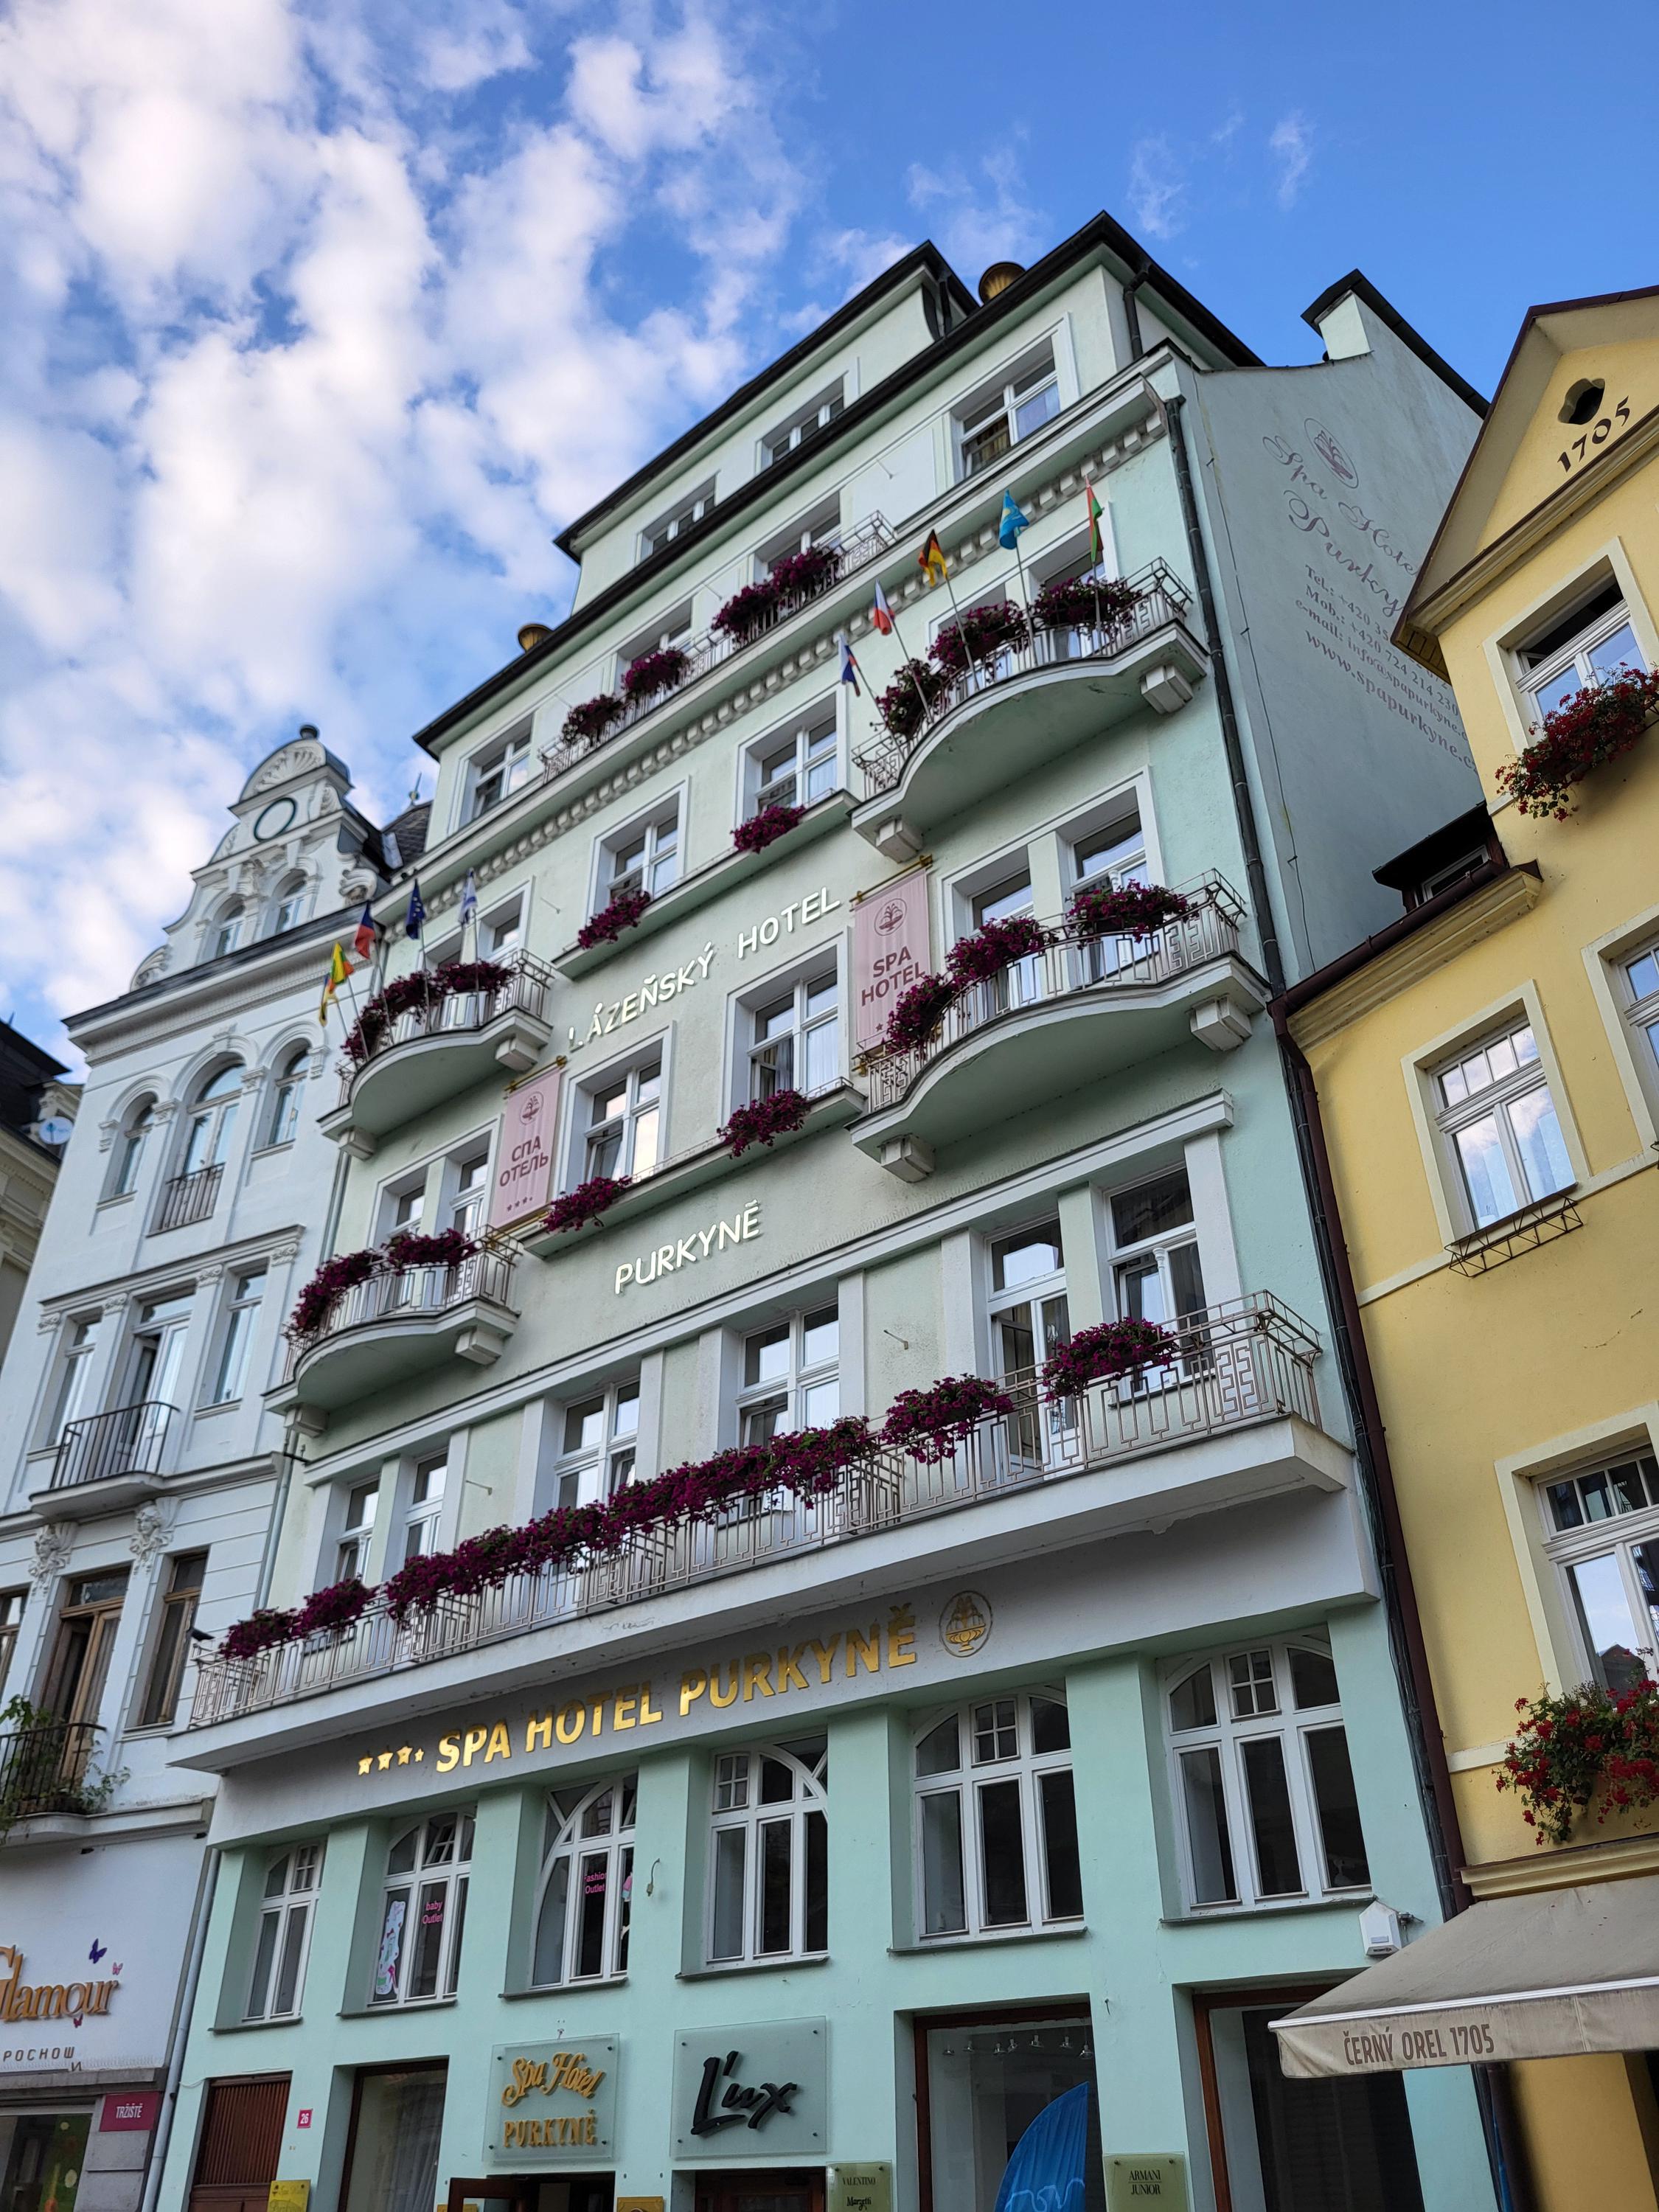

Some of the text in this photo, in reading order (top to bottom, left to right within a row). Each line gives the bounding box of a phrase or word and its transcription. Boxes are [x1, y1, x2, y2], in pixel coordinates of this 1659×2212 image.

[1557, 395, 1630, 473] 1705
[1283, 490, 1405, 618] Purky
[1338, 502, 1418, 576] Hote
[1339, 594, 1371, 625] +420
[1305, 584, 1345, 625] Mob.:
[1351, 622, 1381, 653] +420
[1385, 650, 1408, 675] 724
[1411, 672, 1433, 696] 214
[1347, 637, 1468, 742] info@spapurkyne.c
[568, 886, 841, 1053] LÁZEŇSKÝ HOTEL
[861, 961, 926, 1007] HOTEL
[873, 946, 911, 978] SPA
[499, 1152, 549, 1187] ОТЕЛЬ
[512, 1135, 541, 1162] СПА
[615, 1200, 762, 1295] PURKYNĚ
[435, 1603, 918, 1773] SPA HOTEL PURKYNĚ
[1343, 2023, 1495, 2066] ČERNÝ OREL 1705
[502, 2052, 605, 2107] Spa Hotel
[300, 2112, 310, 2124] 26
[842, 2177, 876, 2186] VALENTINO
[1128, 2168, 1161, 2181] ARMANI
[1131, 2183, 1161, 2195] JUNIOR
